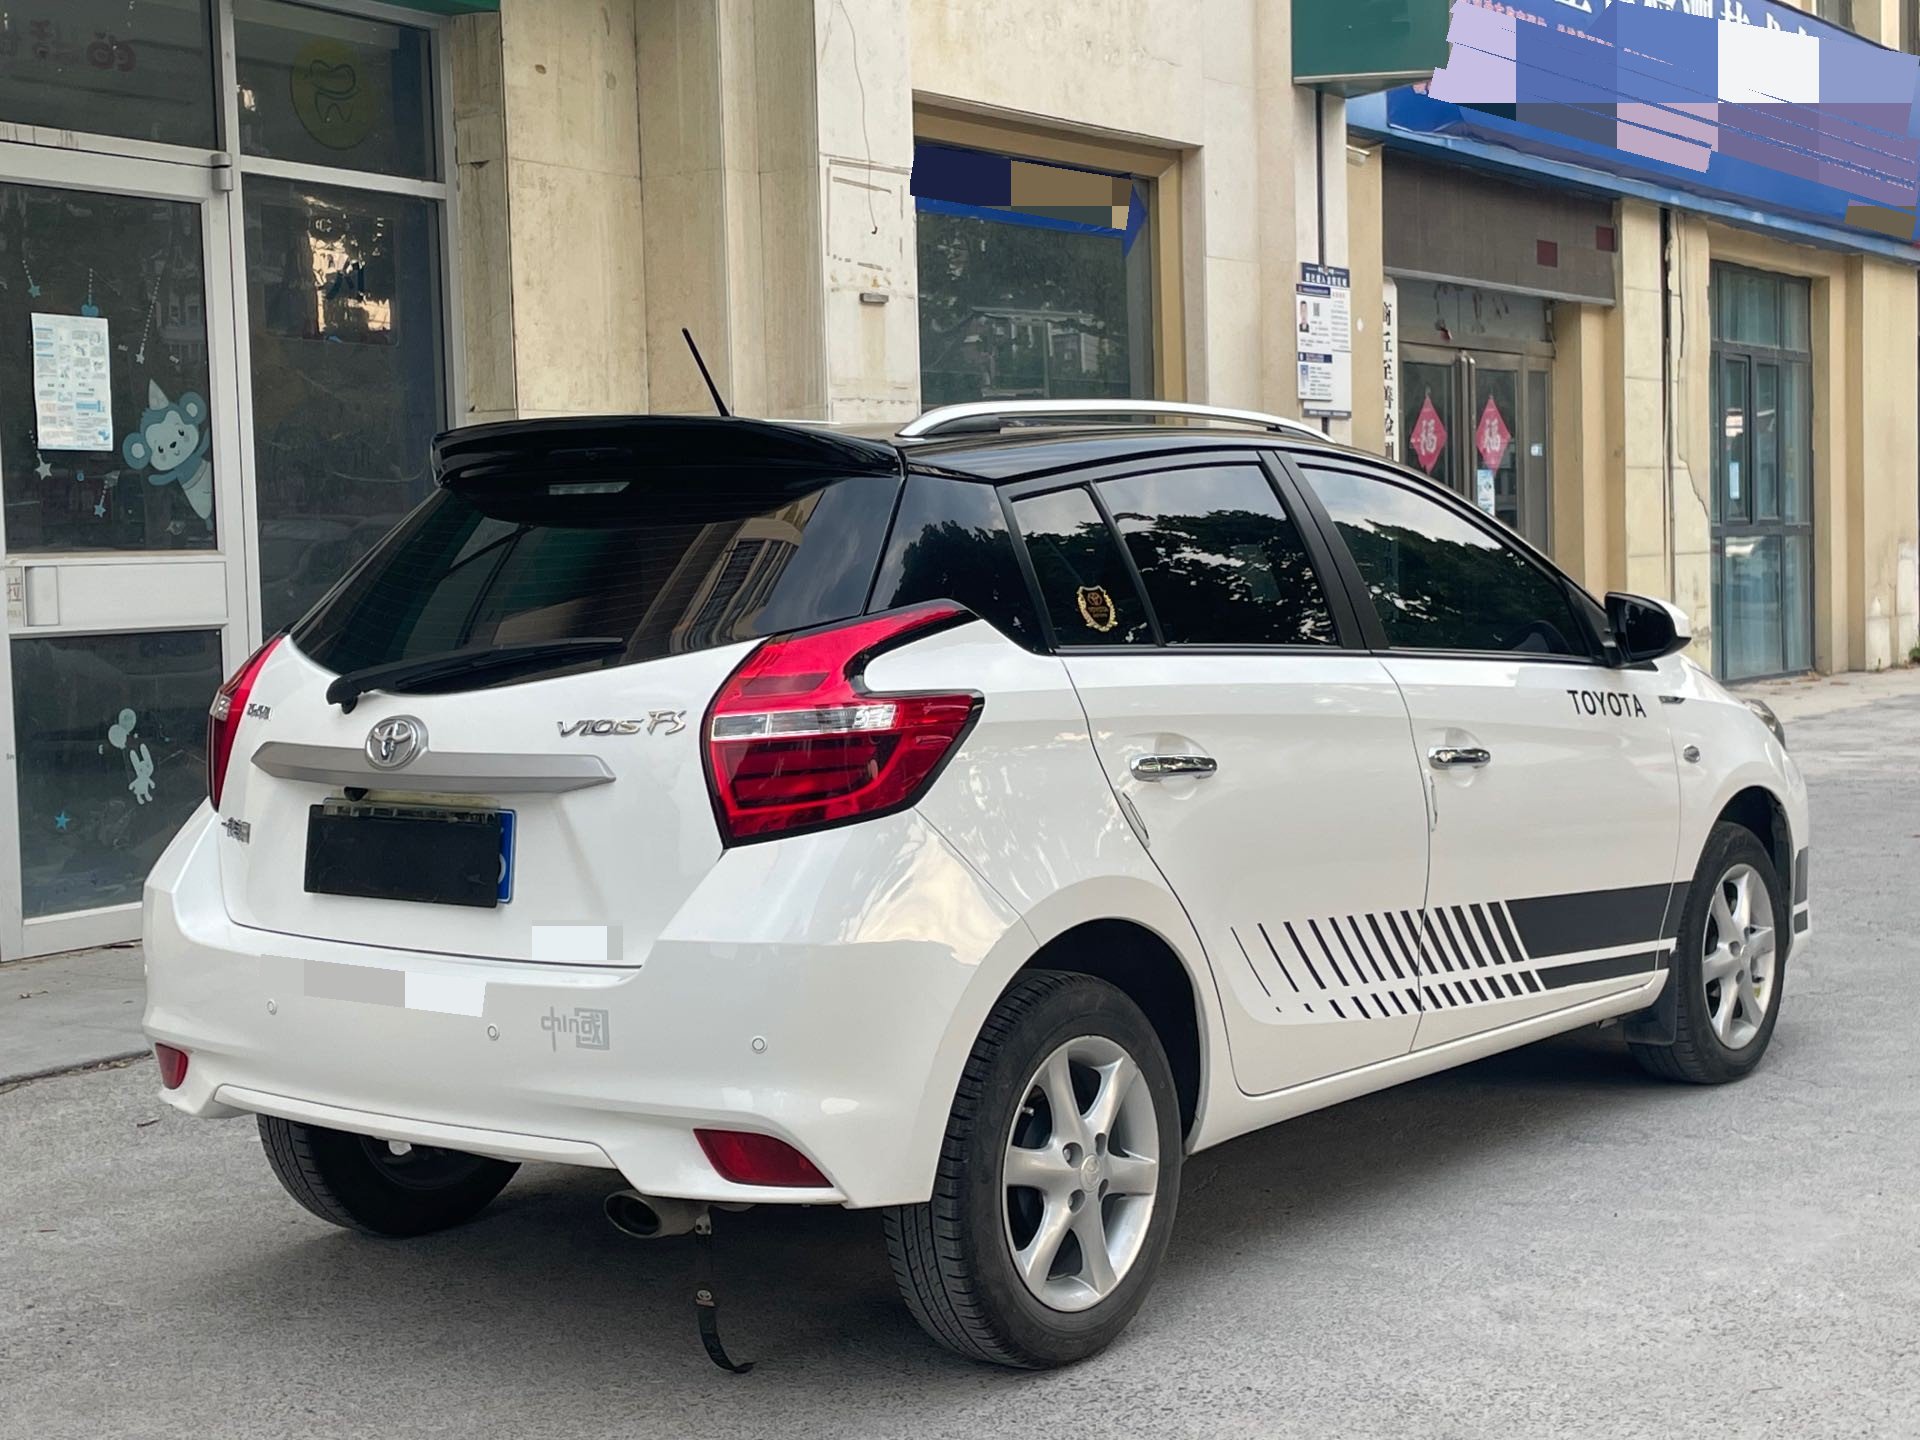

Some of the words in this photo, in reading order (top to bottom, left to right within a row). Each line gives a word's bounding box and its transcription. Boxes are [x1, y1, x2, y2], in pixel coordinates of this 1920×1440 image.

[1420, 419, 1438, 455] 福
[1483, 419, 1501, 453] 福
[1566, 689, 1647, 718] TOYOTA
[557, 718, 644, 738] VIOS
[646, 709, 688, 736] FS
